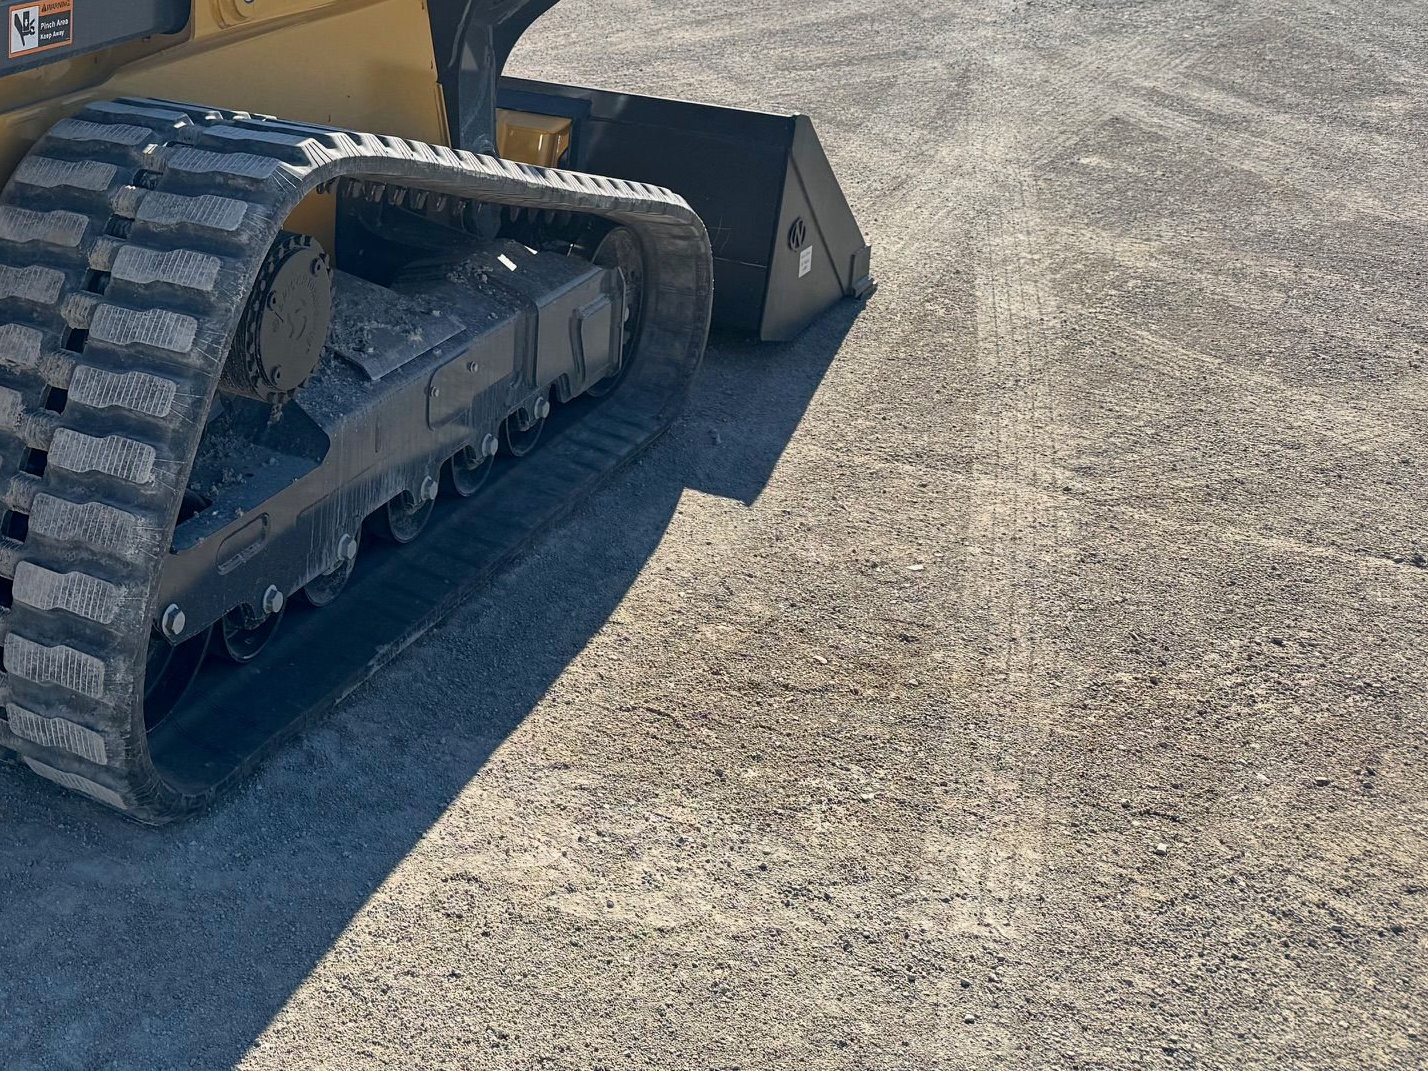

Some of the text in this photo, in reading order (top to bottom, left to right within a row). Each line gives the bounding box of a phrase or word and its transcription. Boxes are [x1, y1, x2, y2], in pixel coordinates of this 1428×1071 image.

[46, 0, 71, 11] WARNING
[40, 18, 69, 30] Pinch Area
[40, 29, 65, 41] Keep Away
